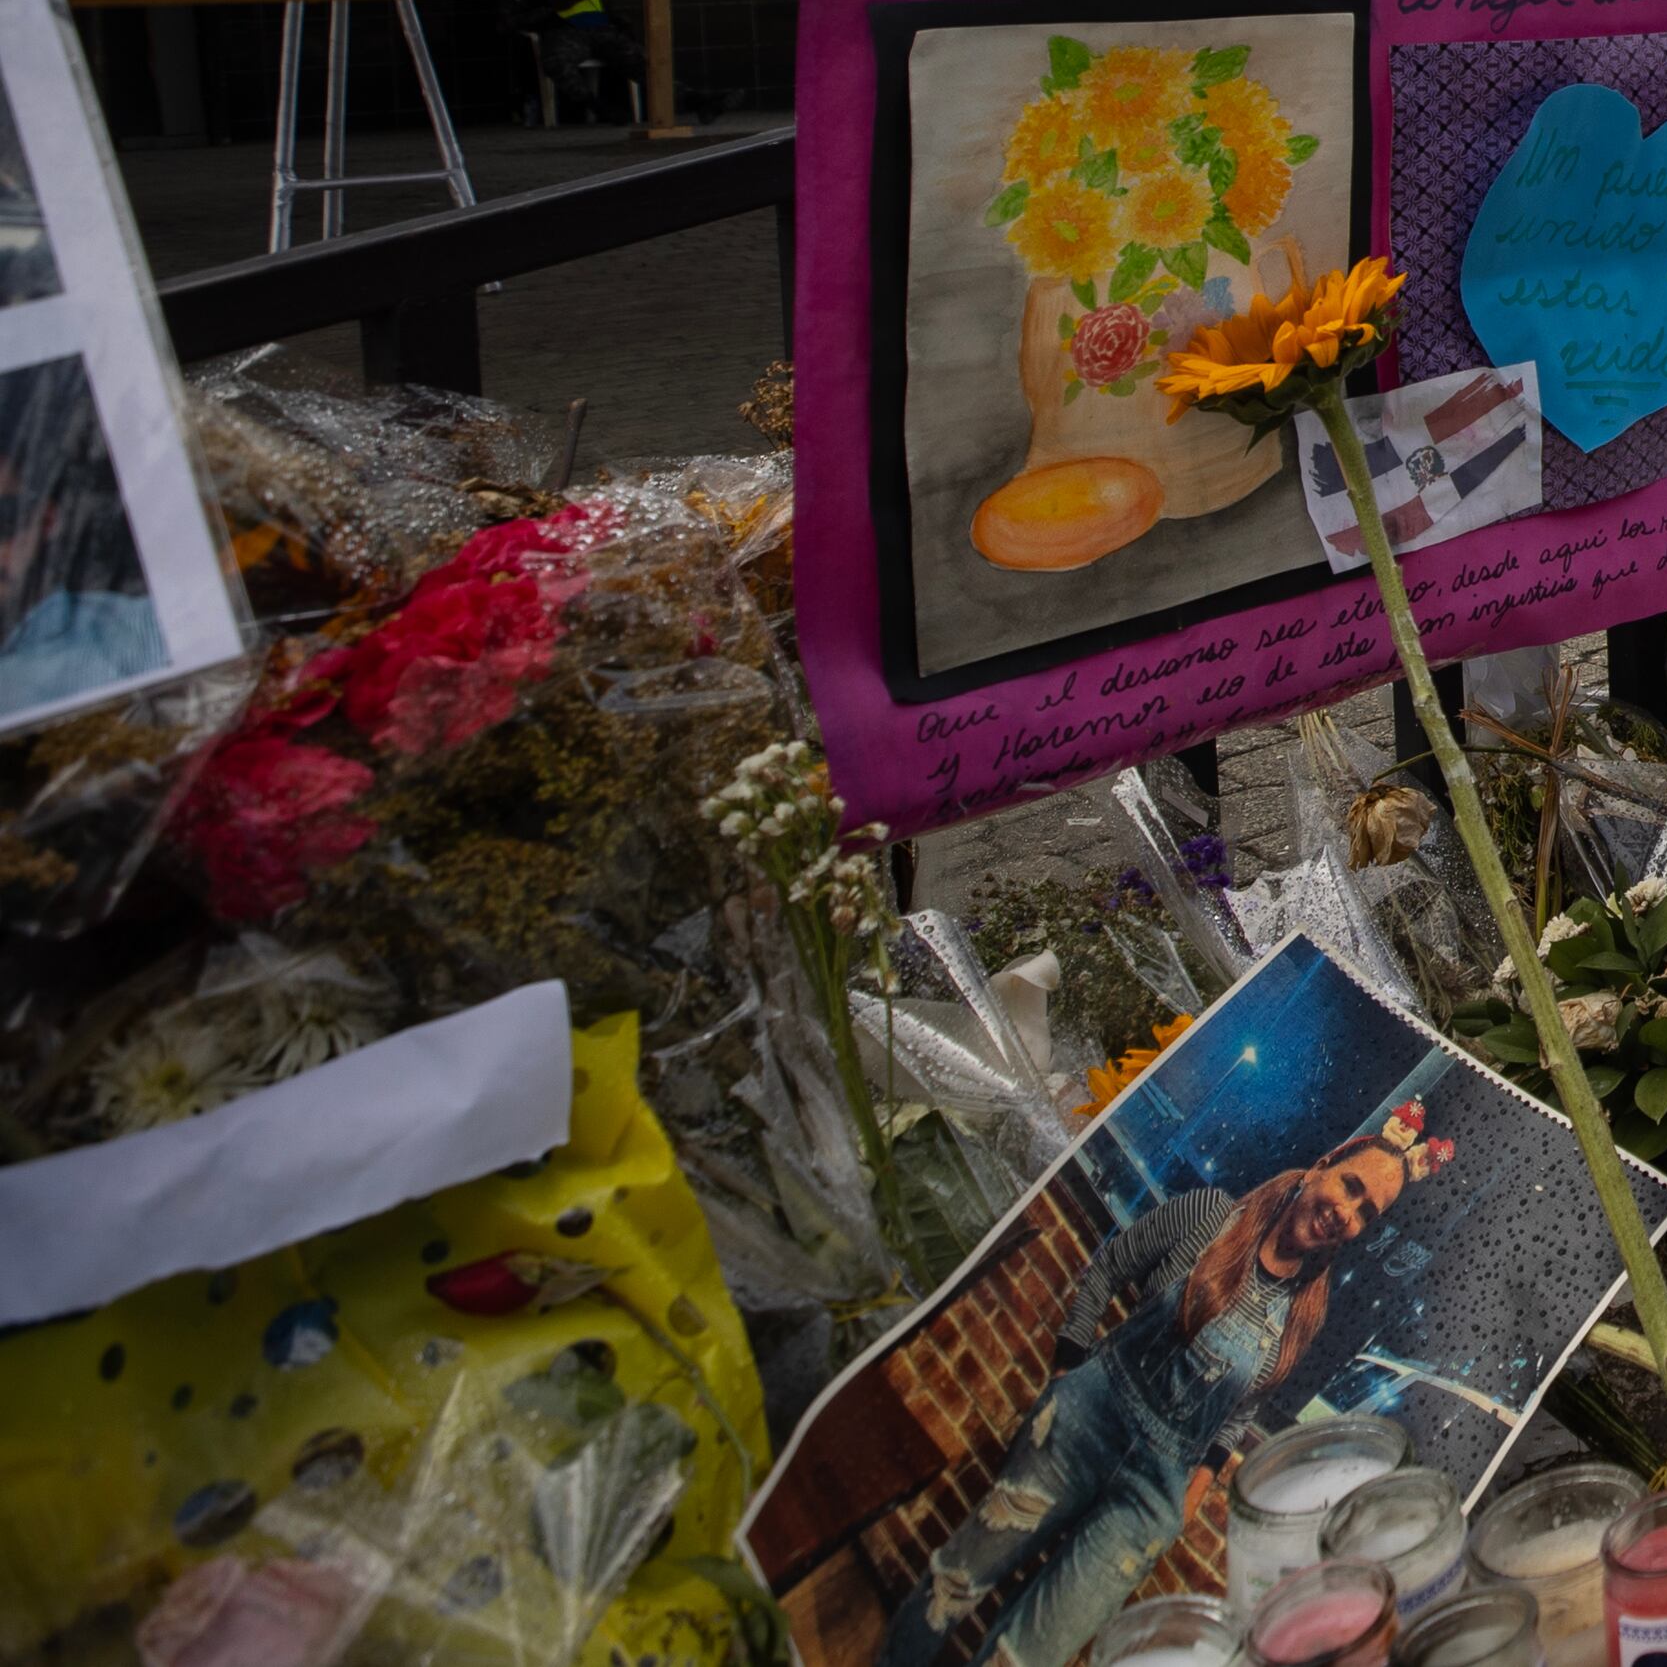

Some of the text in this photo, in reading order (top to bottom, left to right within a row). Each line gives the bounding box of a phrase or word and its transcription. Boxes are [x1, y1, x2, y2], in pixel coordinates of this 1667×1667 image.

[1515, 127, 1581, 188] Un
[1495, 212, 1667, 254] unido
[1498, 269, 1638, 318] estas
[916, 702, 1001, 743] Que
[1035, 671, 1080, 713] el
[1254, 618, 1318, 652] sea
[1330, 579, 1442, 630] etero,
[1451, 548, 1521, 593] desde
[1621, 517, 1656, 540] los
[926, 753, 962, 792] y
[1196, 673, 1246, 705] eco
[1264, 652, 1299, 682] de
[1317, 631, 1378, 670] esta
